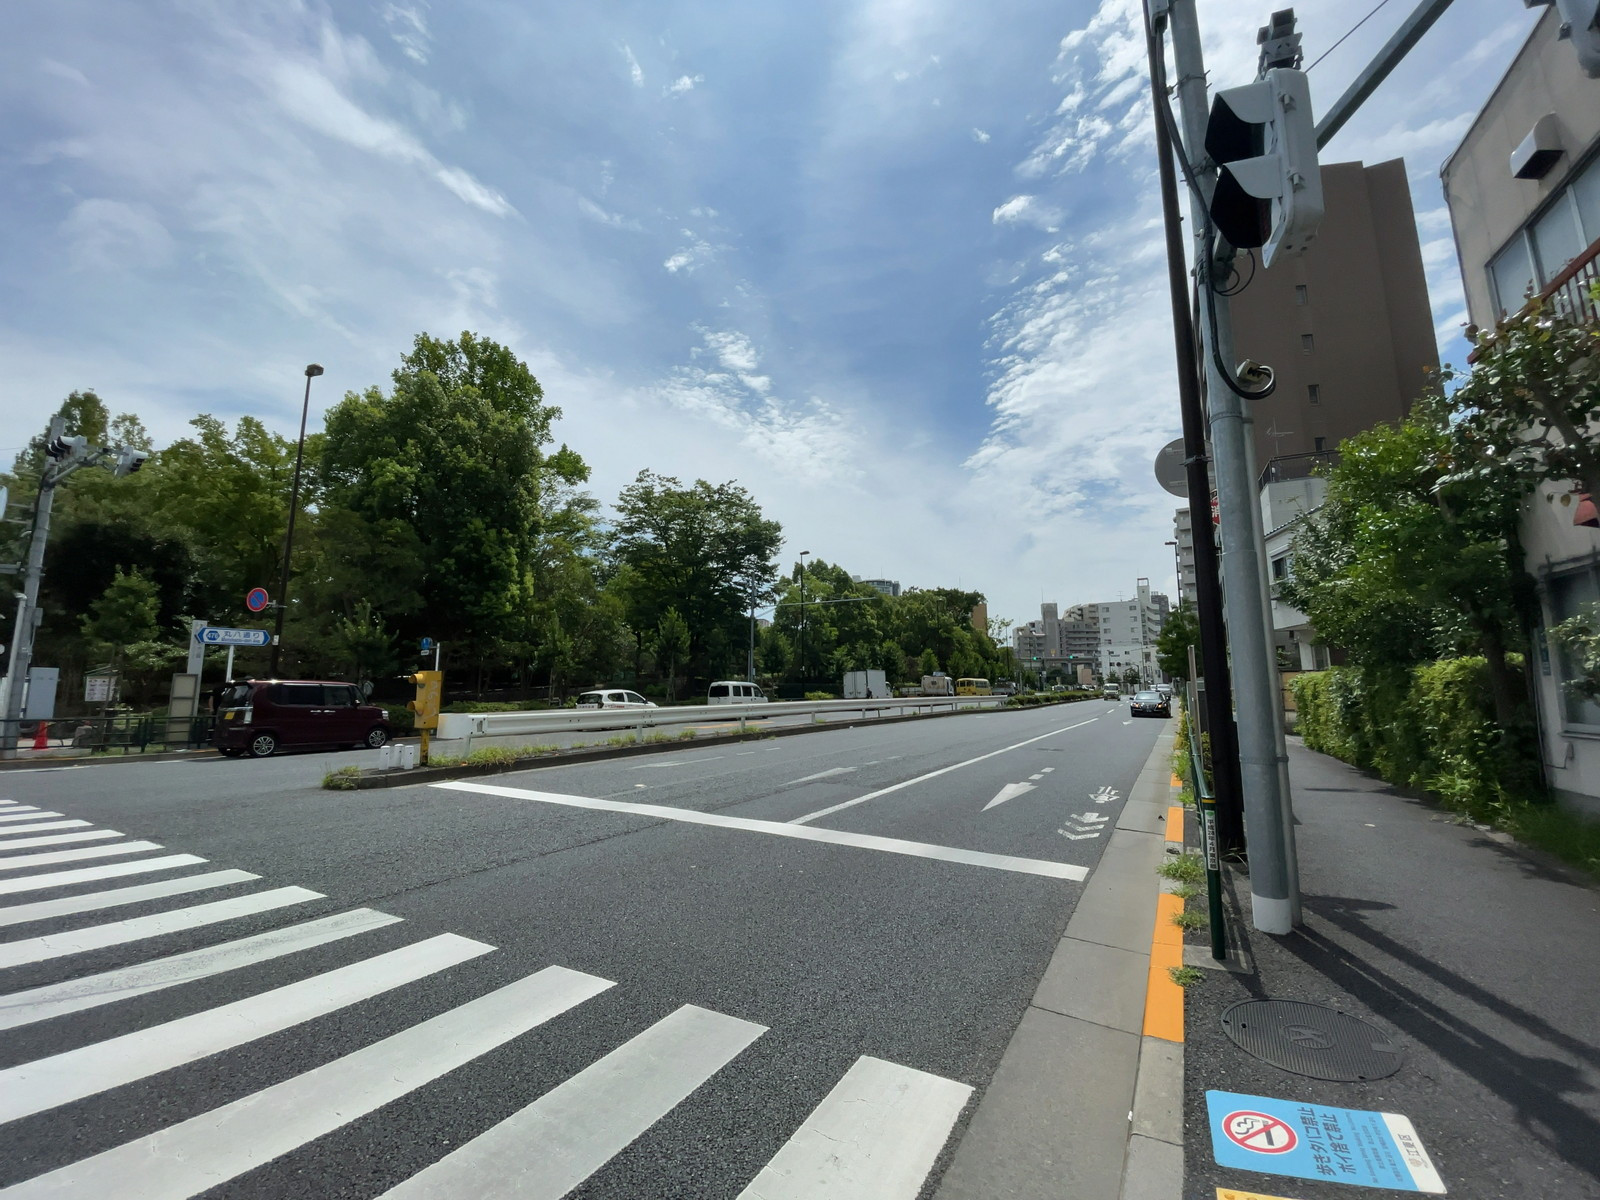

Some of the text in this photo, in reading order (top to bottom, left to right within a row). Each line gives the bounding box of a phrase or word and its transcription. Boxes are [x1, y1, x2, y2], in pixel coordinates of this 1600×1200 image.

[1297, 1106, 1337, 1177] 歩きタバコ禁止
[1319, 1113, 1357, 1175] ポイ捨て禁止
[1397, 1133, 1421, 1157] 江東区
